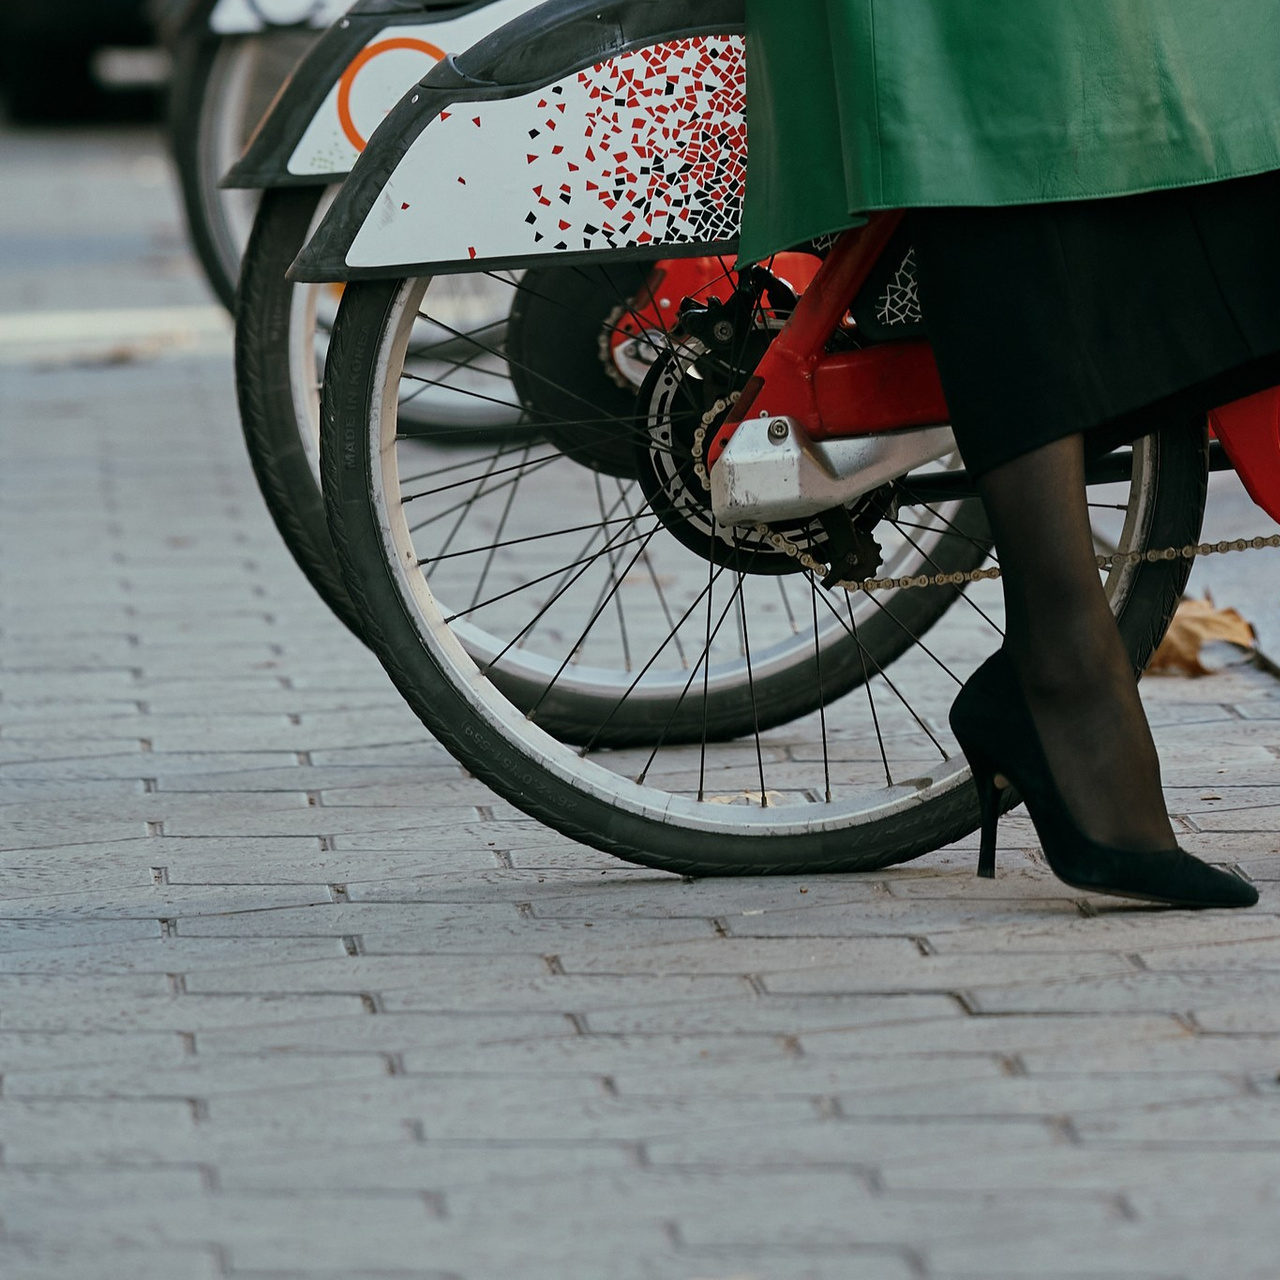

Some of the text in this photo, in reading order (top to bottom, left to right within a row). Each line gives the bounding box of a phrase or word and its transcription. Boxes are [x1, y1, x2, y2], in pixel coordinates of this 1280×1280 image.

[344, 323, 371, 470] MADE IN KOREA
